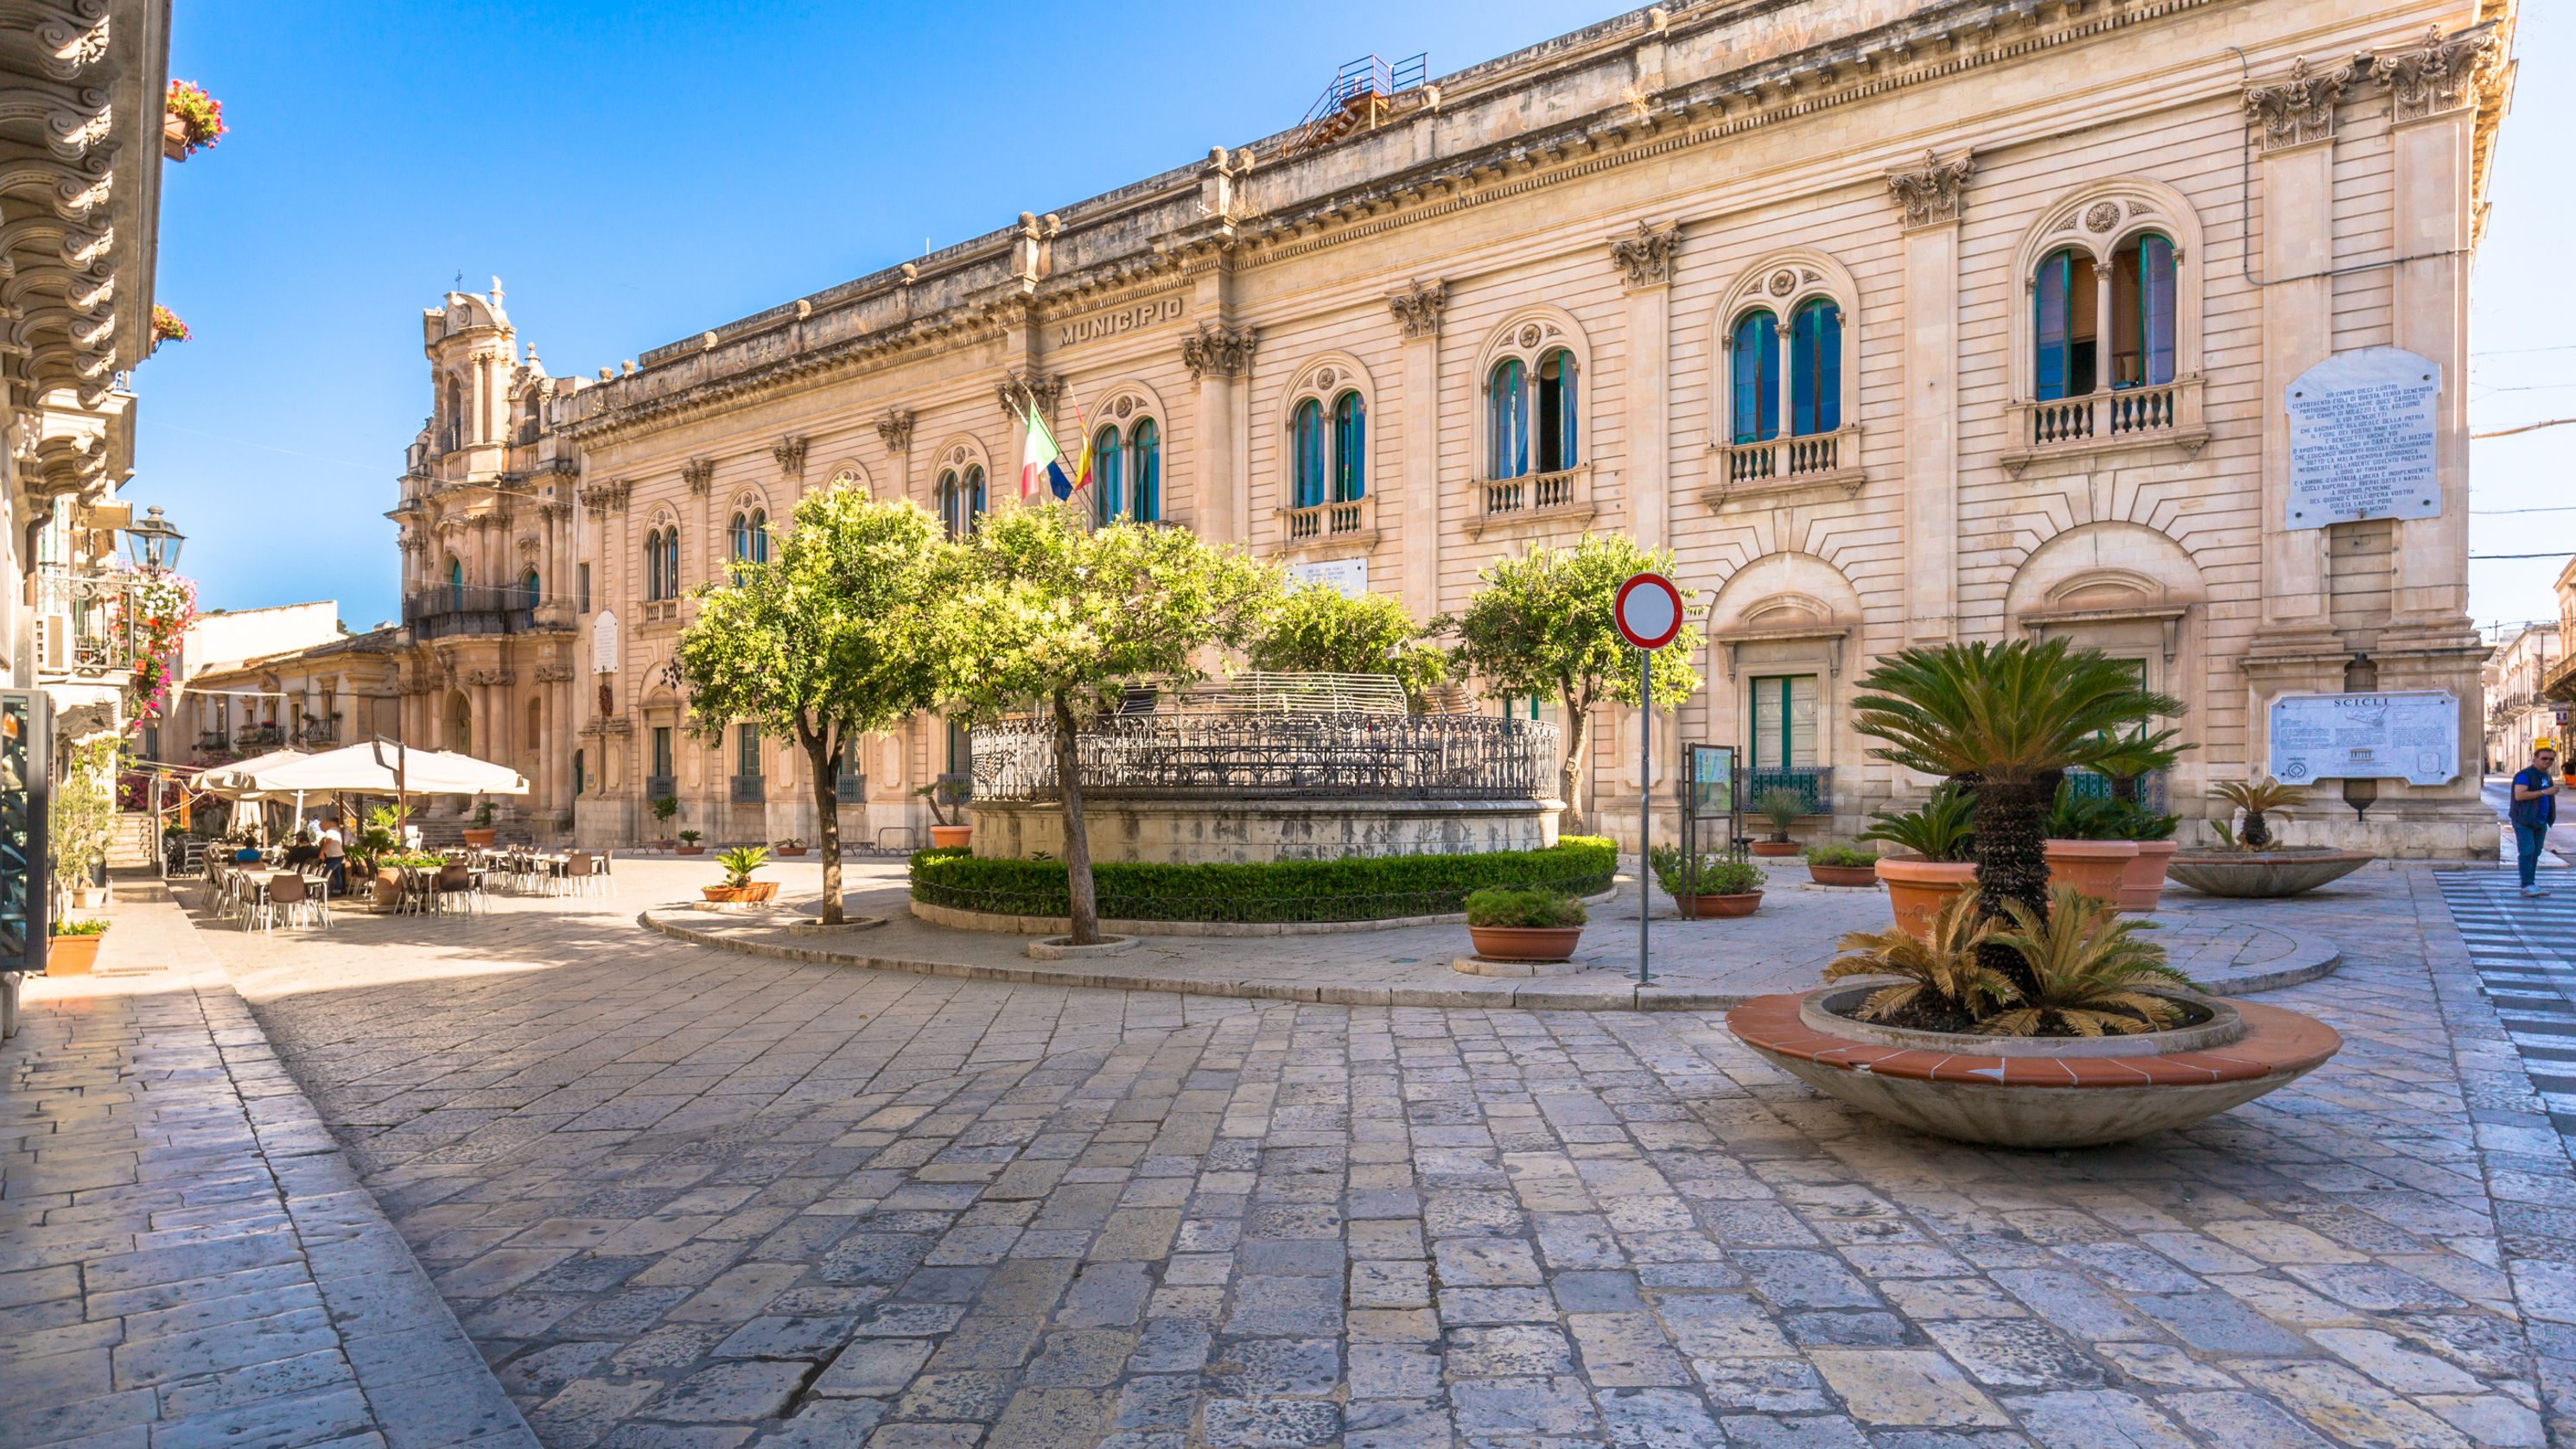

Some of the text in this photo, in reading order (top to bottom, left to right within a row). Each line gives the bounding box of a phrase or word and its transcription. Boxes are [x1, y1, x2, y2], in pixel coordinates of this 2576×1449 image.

[1059, 297, 1183, 346] MUNICIPIO
[2403, 385, 2432, 394] GENEROSA
[2346, 400, 2372, 408] PUGNARE
[2394, 393, 2425, 402] GARIBALDI
[2345, 407, 2371, 415] MILAZZO
[2392, 400, 2420, 409] VOLTURNO
[2354, 412, 2386, 420] BENEDETTI
[2332, 434, 2363, 443] BENEDETTI
[2408, 432, 2432, 440] MAZZINI
[2385, 448, 2417, 456] BORBONICA
[2334, 697, 2388, 707] SCICLI
